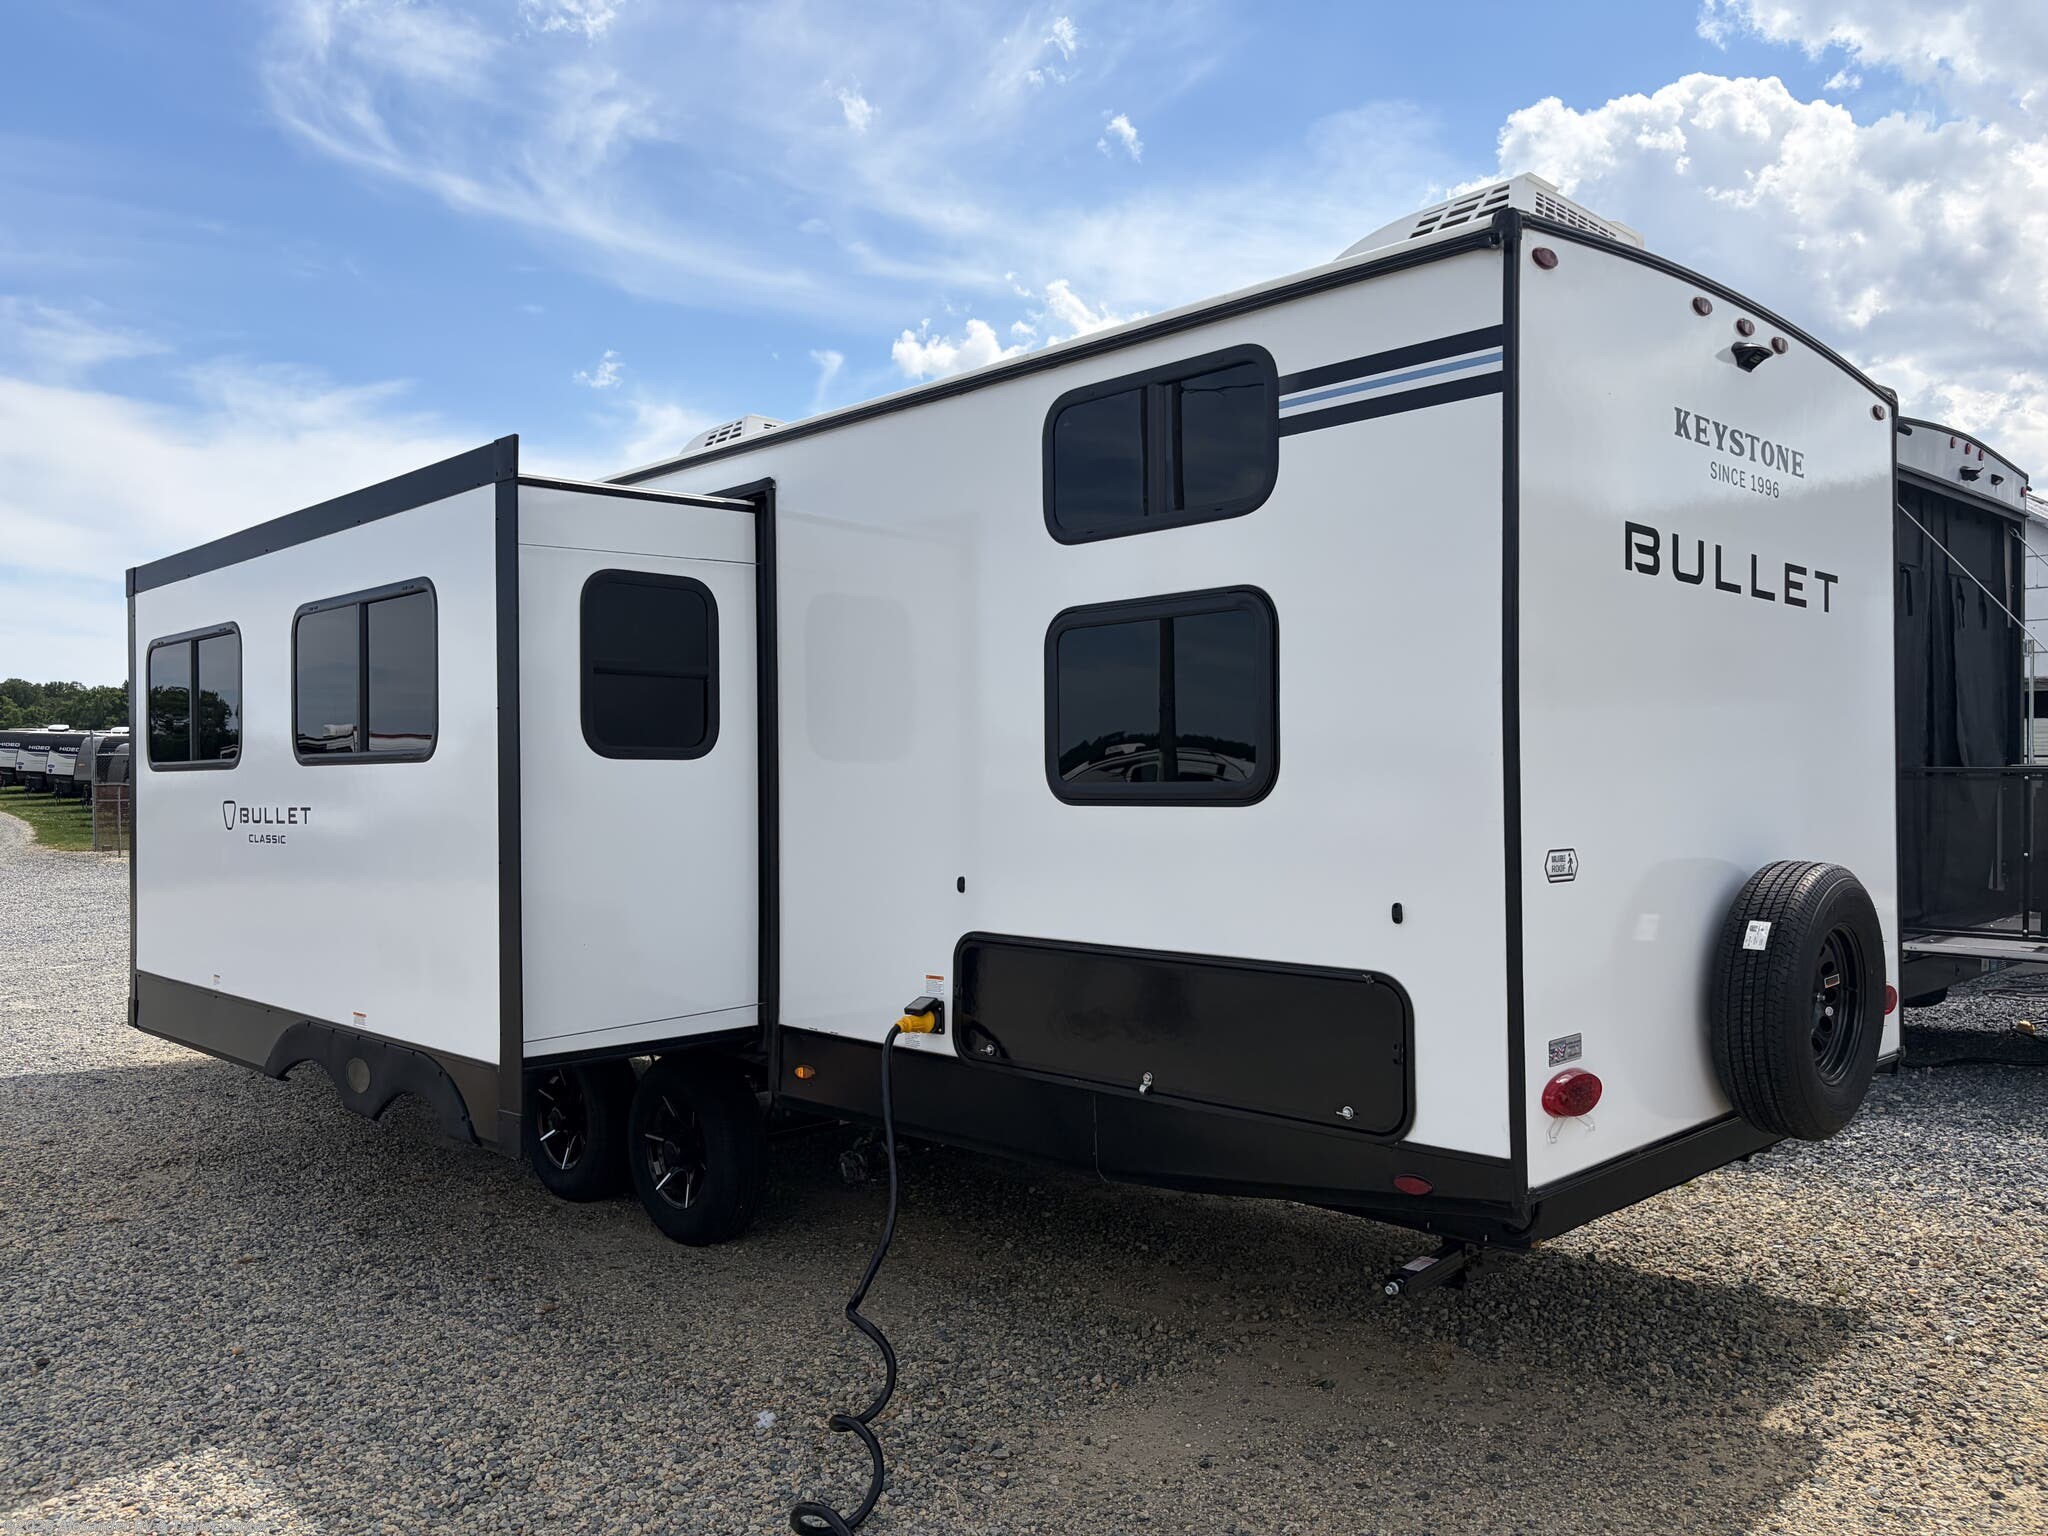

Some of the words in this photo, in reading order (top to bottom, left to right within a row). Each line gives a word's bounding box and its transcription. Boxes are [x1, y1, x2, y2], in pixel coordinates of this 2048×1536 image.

[1674, 406, 1805, 479] KEYSTONE
[1710, 461, 1746, 489] SINCE
[1750, 474, 1780, 498] 1996
[1624, 520, 1839, 613] BULLET
[239, 807, 312, 825] BULLET
[248, 833, 287, 845] CLASSIC
